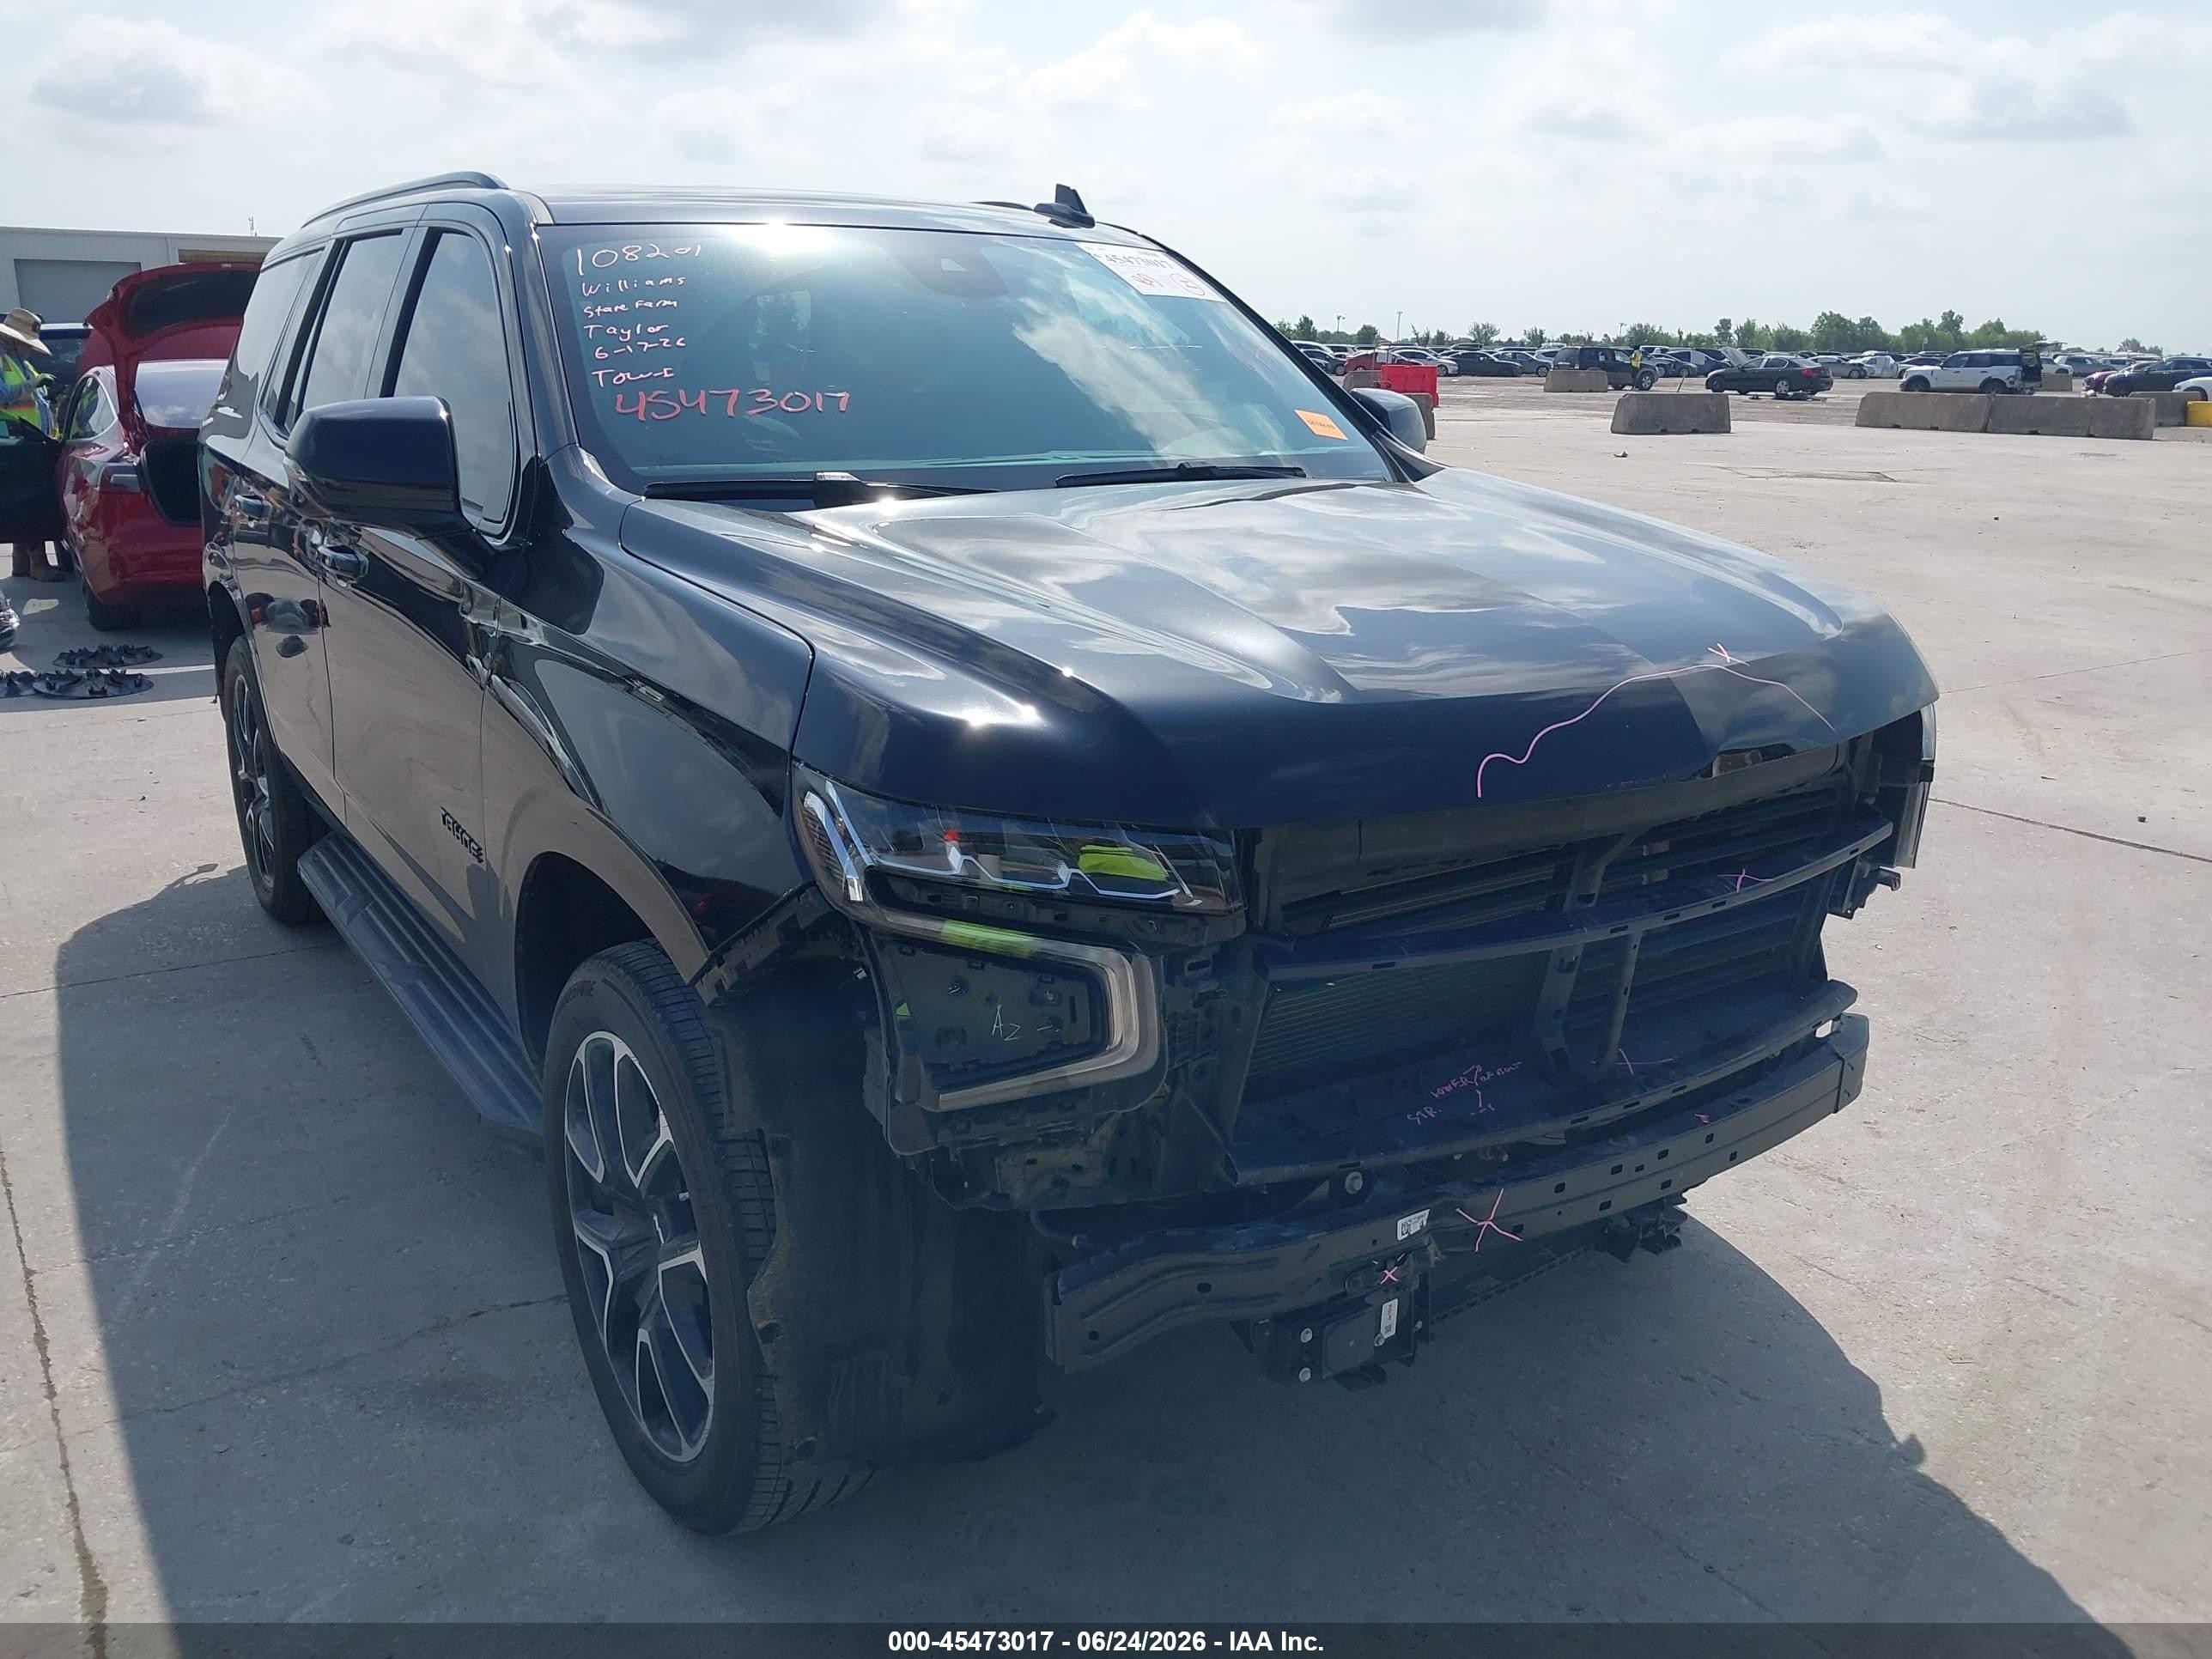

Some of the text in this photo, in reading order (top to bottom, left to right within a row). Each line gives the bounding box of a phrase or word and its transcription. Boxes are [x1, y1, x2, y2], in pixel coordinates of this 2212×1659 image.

[576, 244, 702, 276] 108201
[581, 276, 686, 297] Williams
[584, 323, 670, 342] Taylor
[595, 337, 686, 360] 6-17-26
[615, 389, 850, 421] 45473017
